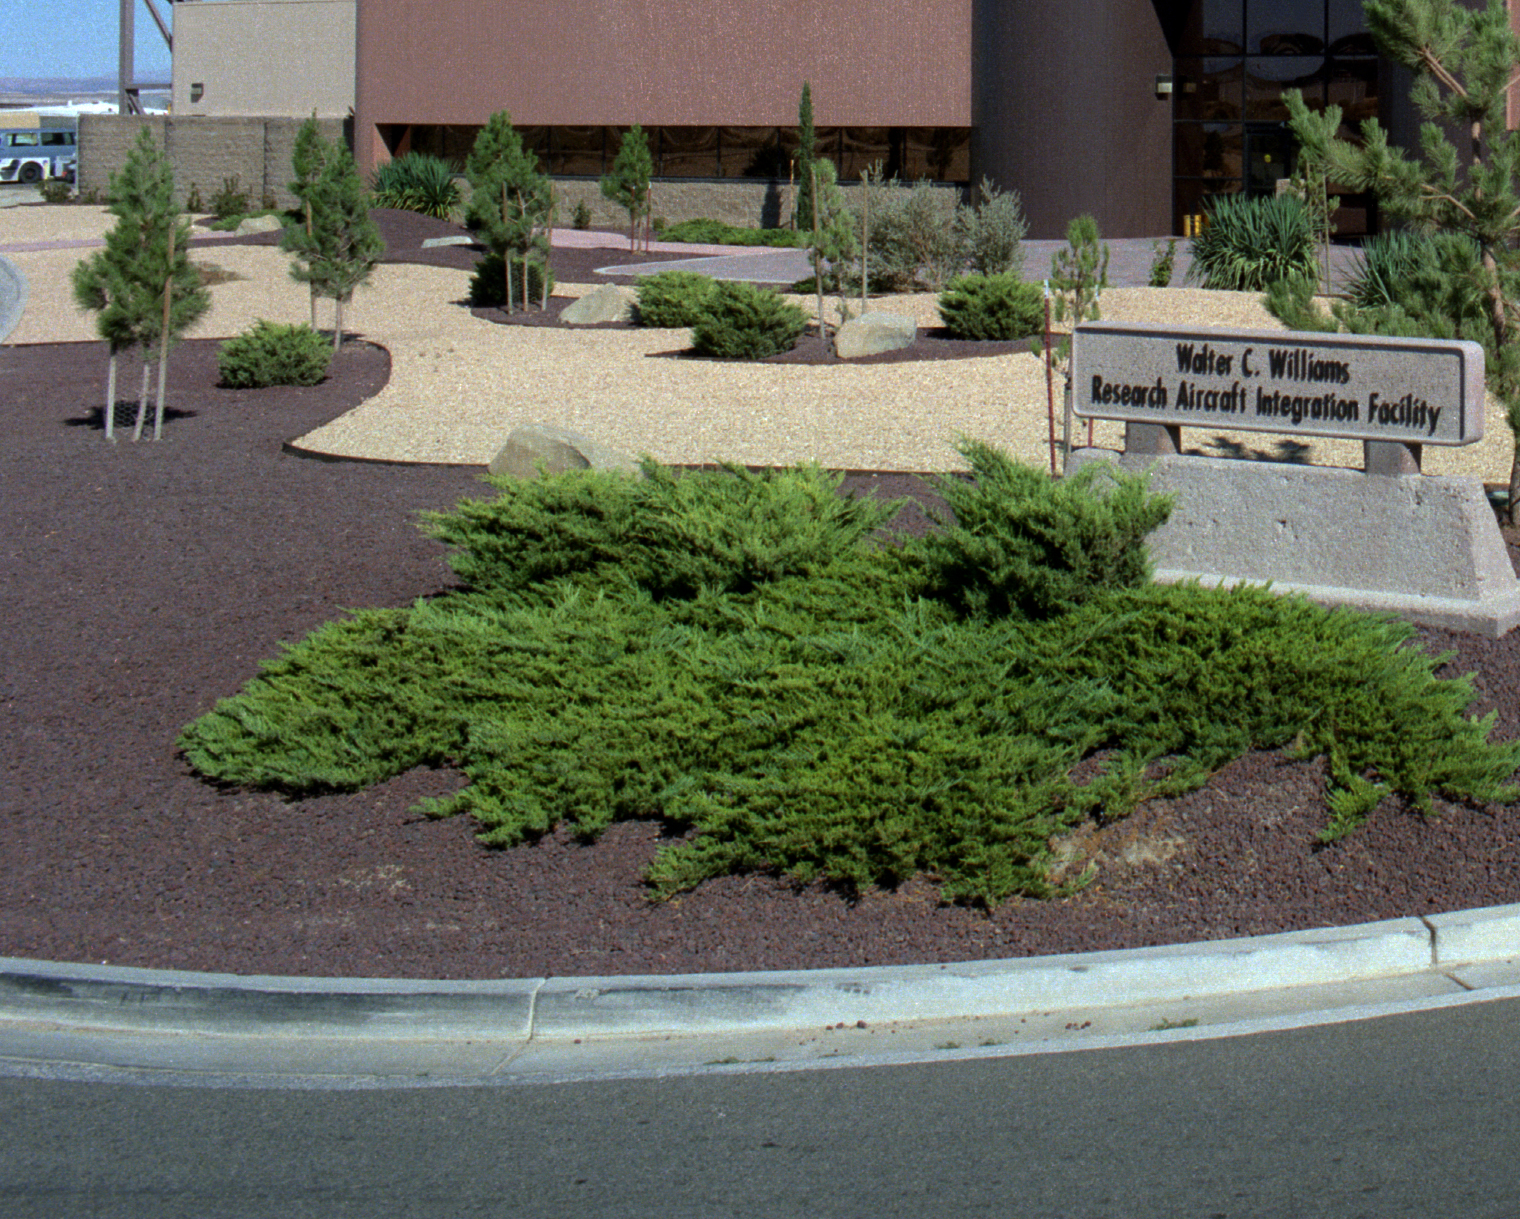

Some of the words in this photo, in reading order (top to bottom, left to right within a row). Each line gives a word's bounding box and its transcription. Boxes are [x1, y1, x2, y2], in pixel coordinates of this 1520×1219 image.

[1176, 343, 1233, 376] Walter
[1241, 347, 1260, 378] C.
[1268, 348, 1350, 384] Williams
[1091, 374, 1168, 410] Research
[1174, 380, 1247, 414] Aircraft
[1256, 385, 1359, 426] Integration
[1367, 392, 1441, 436] Facility
